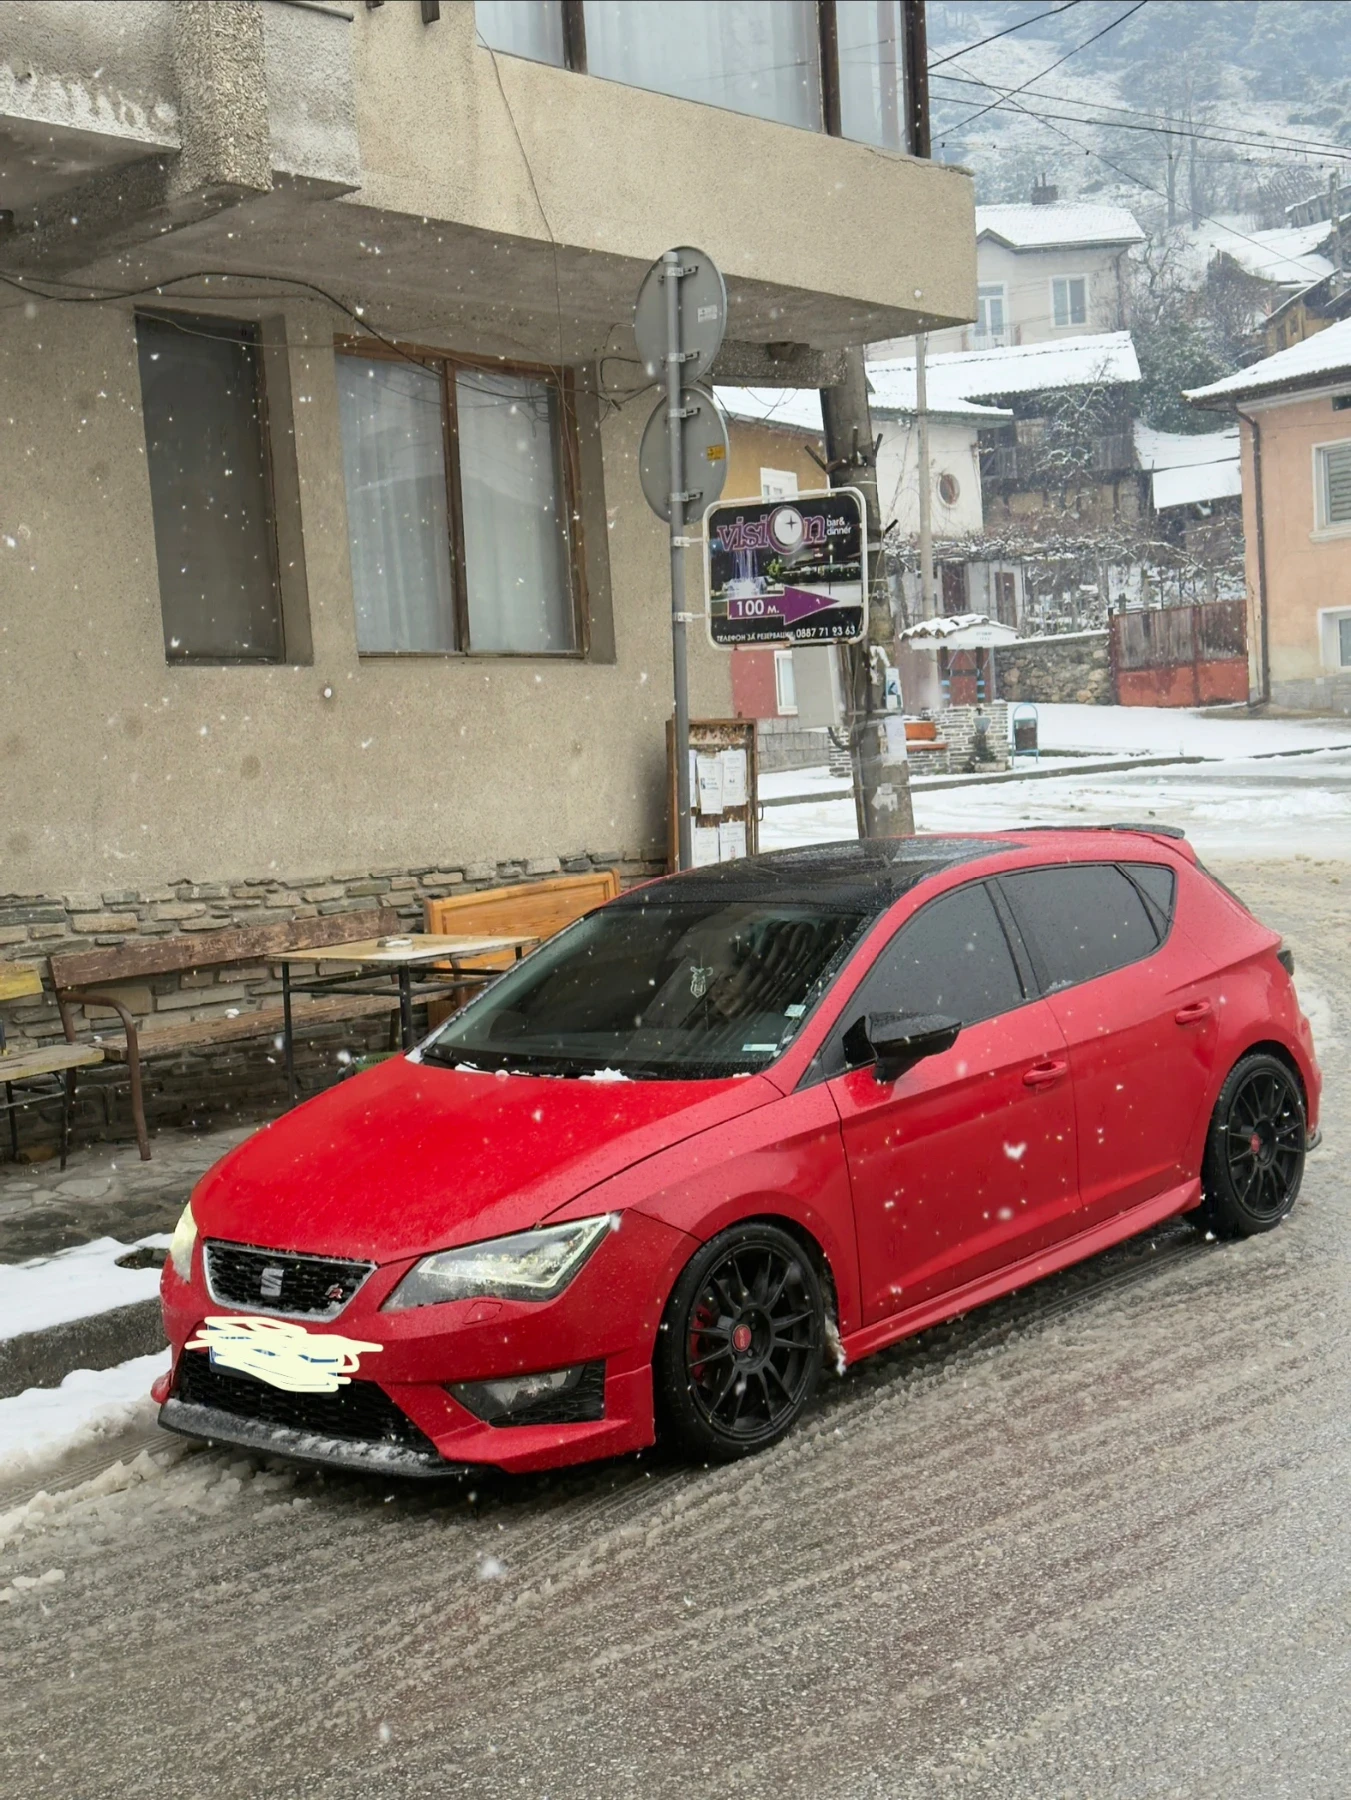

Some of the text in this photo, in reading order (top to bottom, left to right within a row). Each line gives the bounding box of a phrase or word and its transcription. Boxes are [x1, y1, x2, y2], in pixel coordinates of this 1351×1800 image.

[737, 599, 765, 616] 100
[716, 633, 746, 643] ТЕЛЕФОН
[796, 627, 817, 639] 0887
[819, 627, 829, 637] 71
[845, 625, 855, 636] 63
